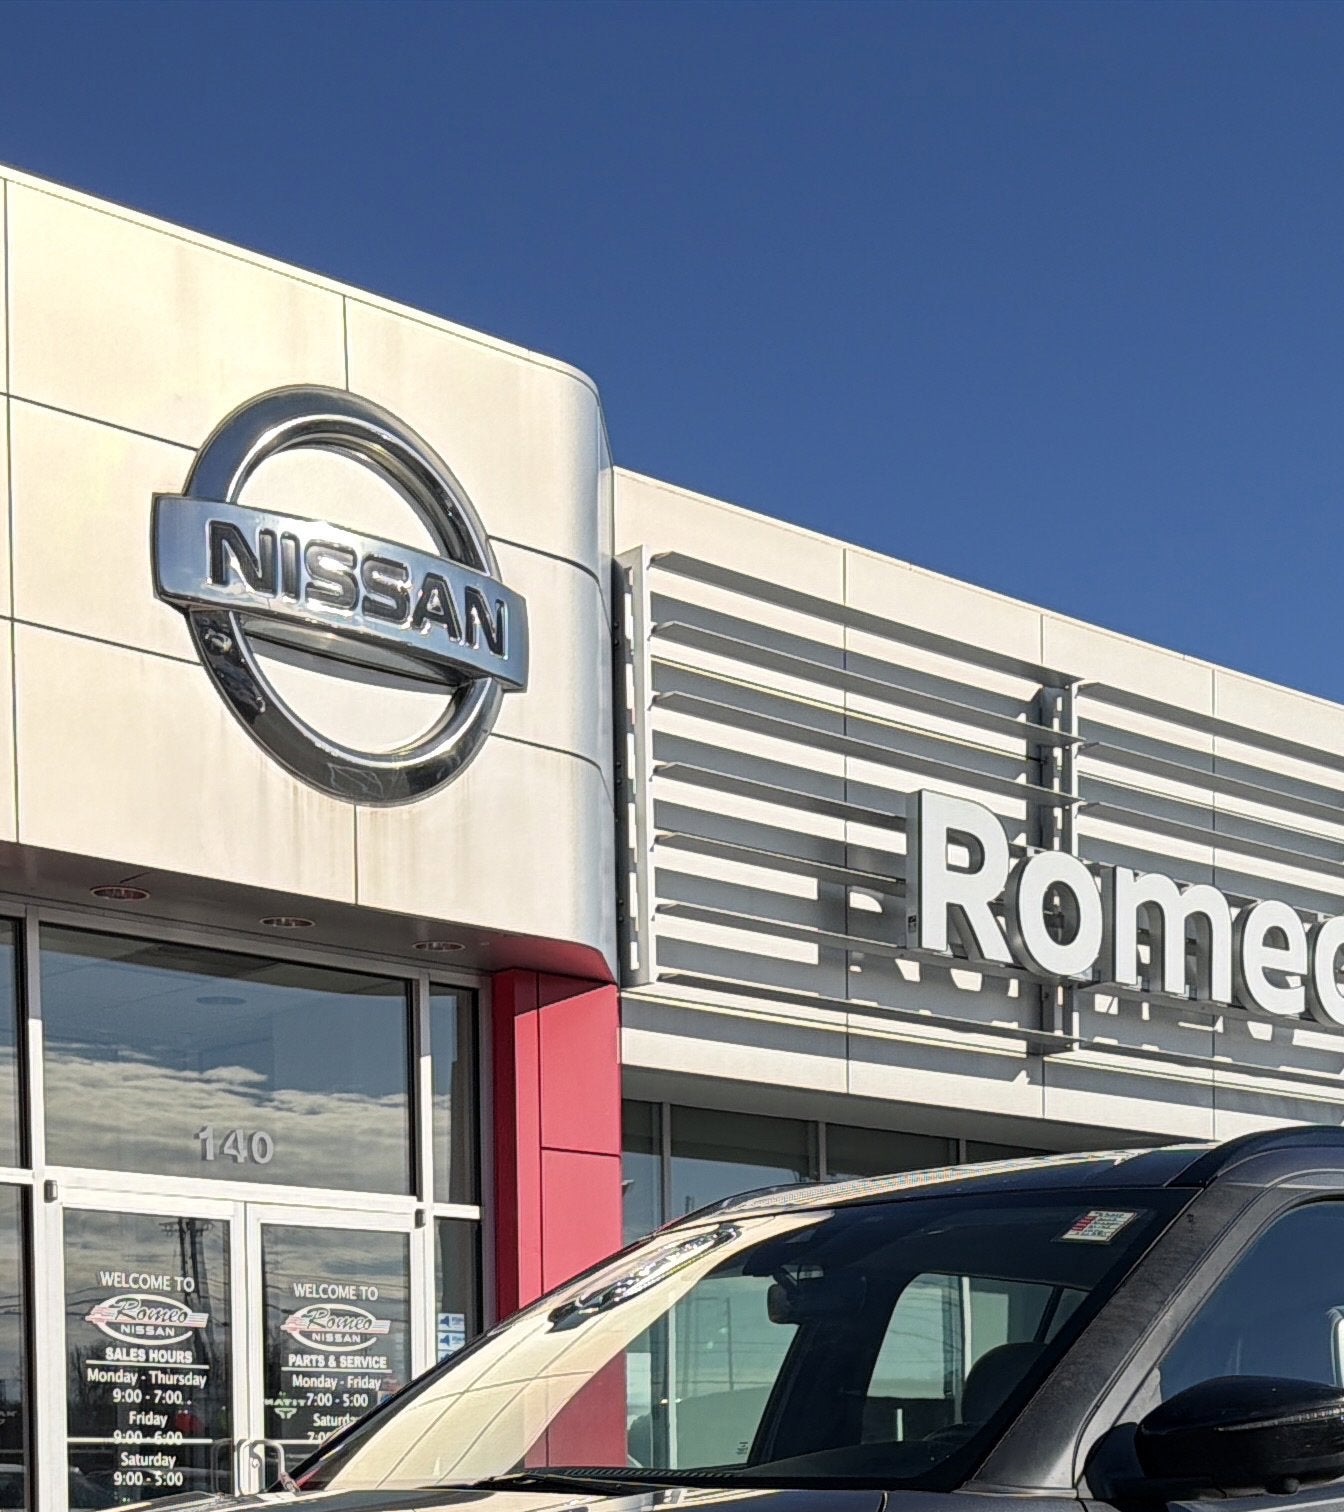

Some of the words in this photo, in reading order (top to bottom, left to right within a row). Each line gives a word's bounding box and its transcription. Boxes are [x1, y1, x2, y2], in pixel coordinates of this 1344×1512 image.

[206, 519, 508, 659] NISSAN
[195, 1125, 274, 1164] 140
[100, 1271, 171, 1291] WELCOME
[175, 1277, 195, 1292] TO
[294, 1283, 357, 1299] WELCOME
[360, 1286, 378, 1300] TO
[113, 1299, 188, 1323] Romeo
[302, 1308, 372, 1330] Romeo
[120, 1324, 175, 1336] NISSAN
[312, 1333, 361, 1343] NISSAN
[105, 1346, 146, 1361] SALES
[149, 1349, 193, 1363] HOURS
[288, 1354, 325, 1367] PARTS
[328, 1355, 336, 1368] &
[339, 1356, 387, 1368] SERVICE
[87, 1368, 138, 1386] Monday
[149, 1370, 207, 1389] Thursday
[292, 1374, 337, 1390] Monday
[347, 1375, 381, 1391] Friday
[112, 1389, 142, 1403] 9:00
[154, 1390, 182, 1404] 7:00
[306, 1393, 332, 1406] 7:00
[343, 1393, 368, 1407] 5:00
[129, 1411, 168, 1428] Friday
[313, 1412, 361, 1427] Saturda
[114, 1430, 142, 1444] 9:00
[121, 1452, 176, 1469] Saturday
[114, 1472, 143, 1485] 9:00
[155, 1472, 183, 1486] 5:00
